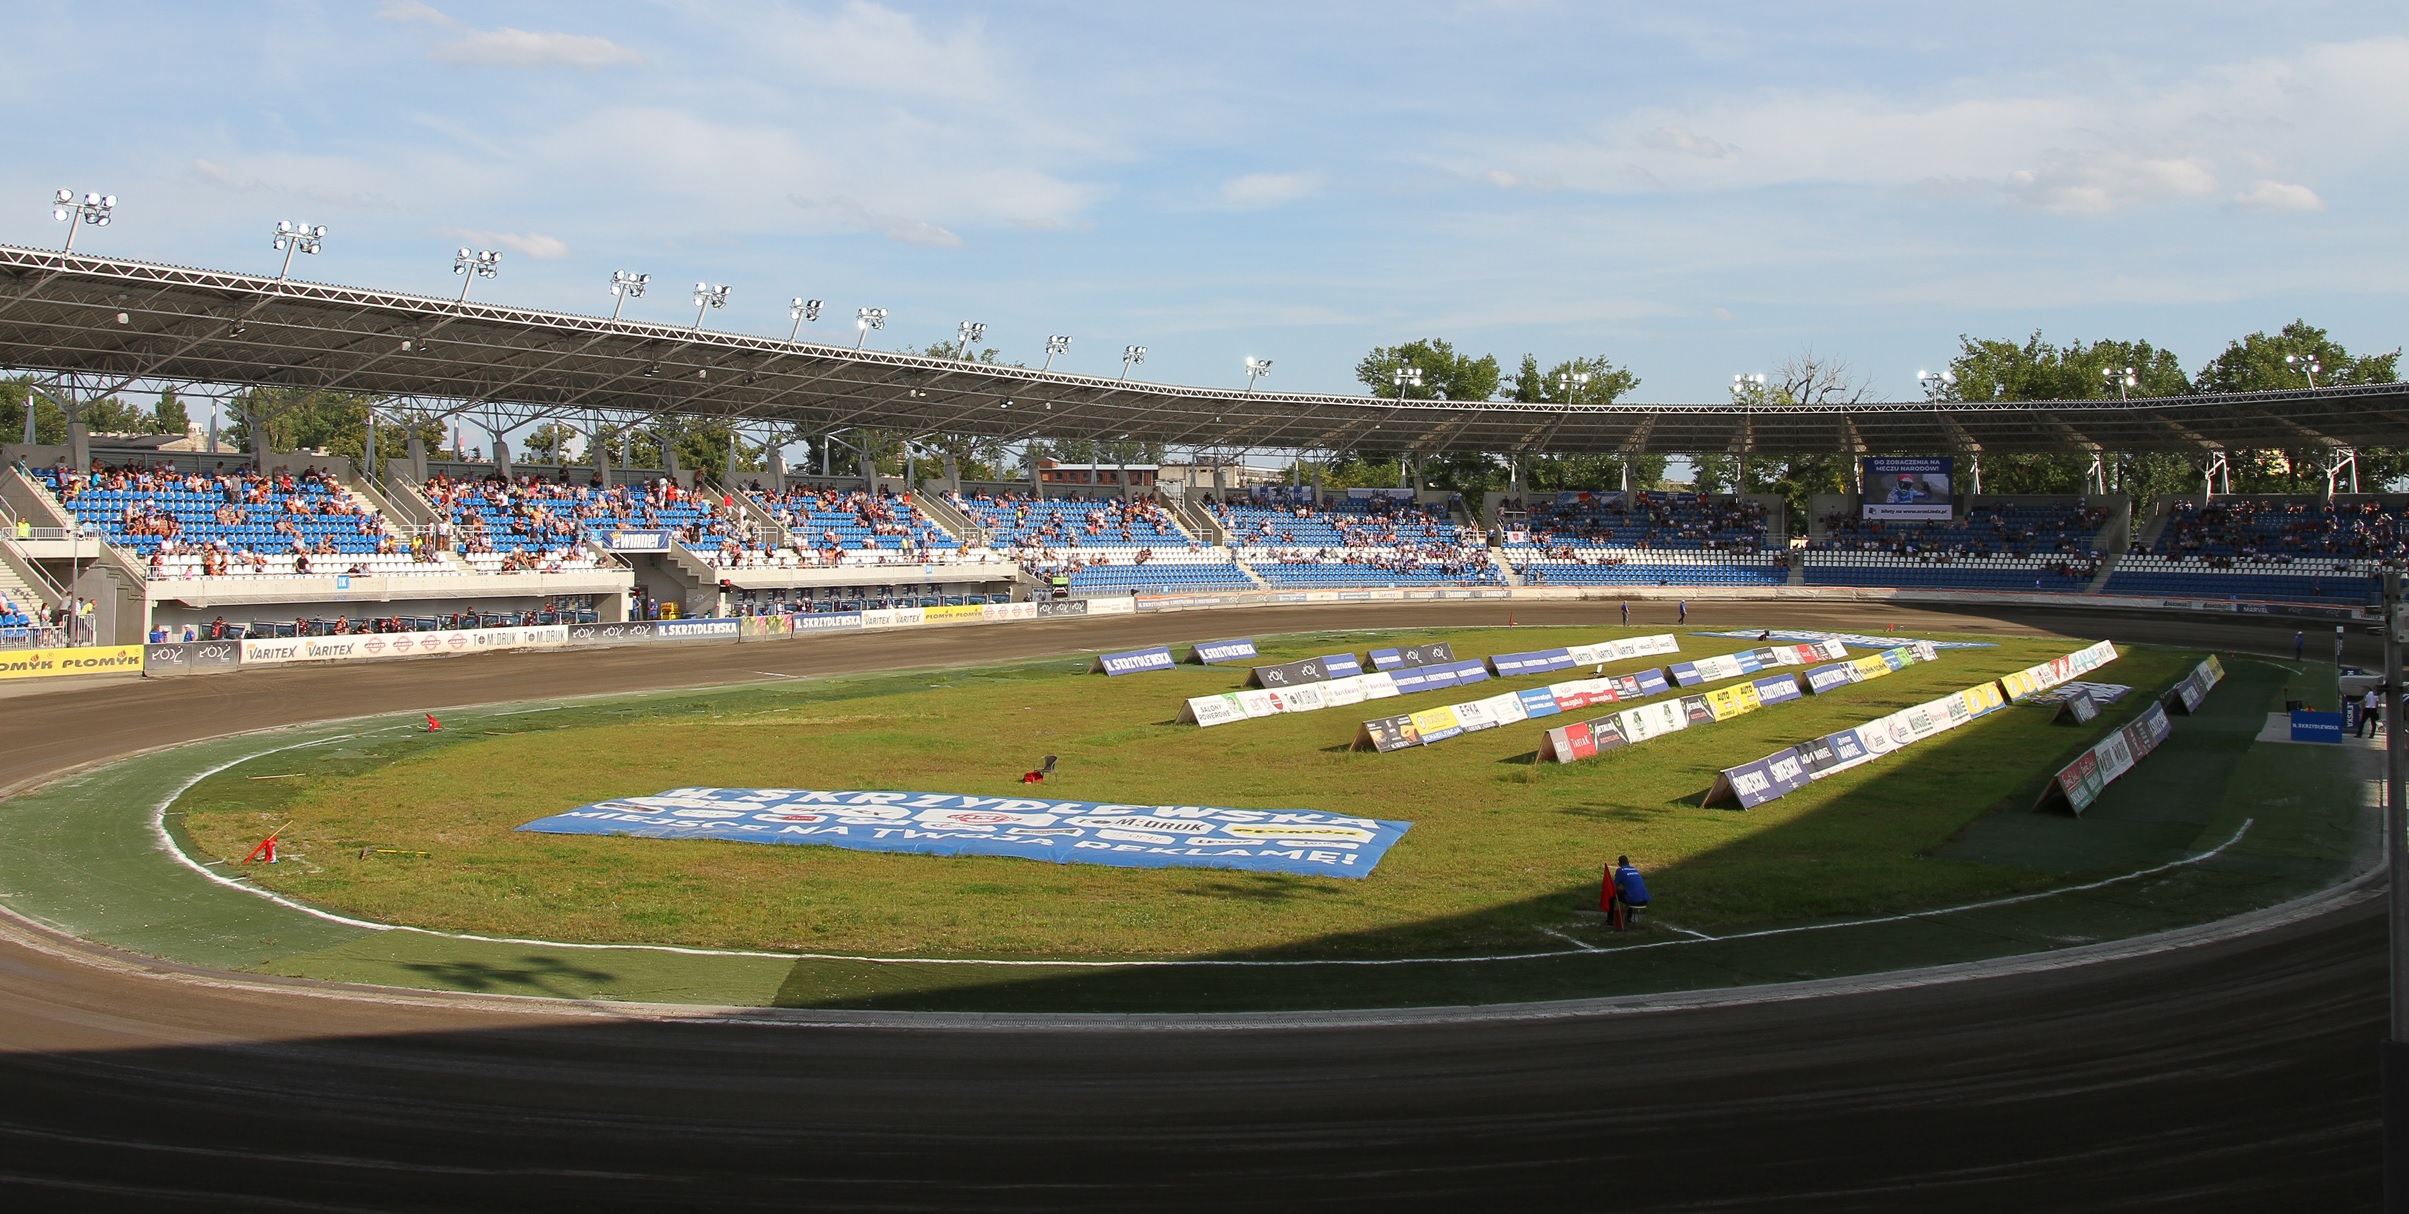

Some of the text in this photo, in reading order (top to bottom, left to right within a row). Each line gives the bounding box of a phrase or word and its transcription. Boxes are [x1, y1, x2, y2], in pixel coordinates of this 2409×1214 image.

[804, 615, 861, 627] SKRZYDLEWSKA
[864, 615, 891, 625] VARITEX
[895, 613, 921, 623] VARITEX
[658, 622, 737, 637] H. SKRZYDLEWSKA
[249, 645, 298, 660] VARITEX
[308, 643, 355, 657] VARITEX
[62, 656, 139, 668] PŁOMYK
[1113, 652, 1172, 670] SKRZYDLEWSKA
[1740, 685, 1753, 695] AUTO
[1717, 691, 1730, 702] AUTO
[1200, 704, 1222, 713] SALONY
[1460, 704, 1480, 716] EFKA
[1199, 711, 1231, 720] ROWEROWE
[1838, 743, 1861, 760] MARVEL
[666, 787, 724, 800] H.
[736, 788, 1381, 829] SKRZYDLEWSKA
[557, 811, 770, 831] MIEJSCE
[777, 825, 849, 836] NA
[1073, 841, 1359, 865] REKLAMĘ!
